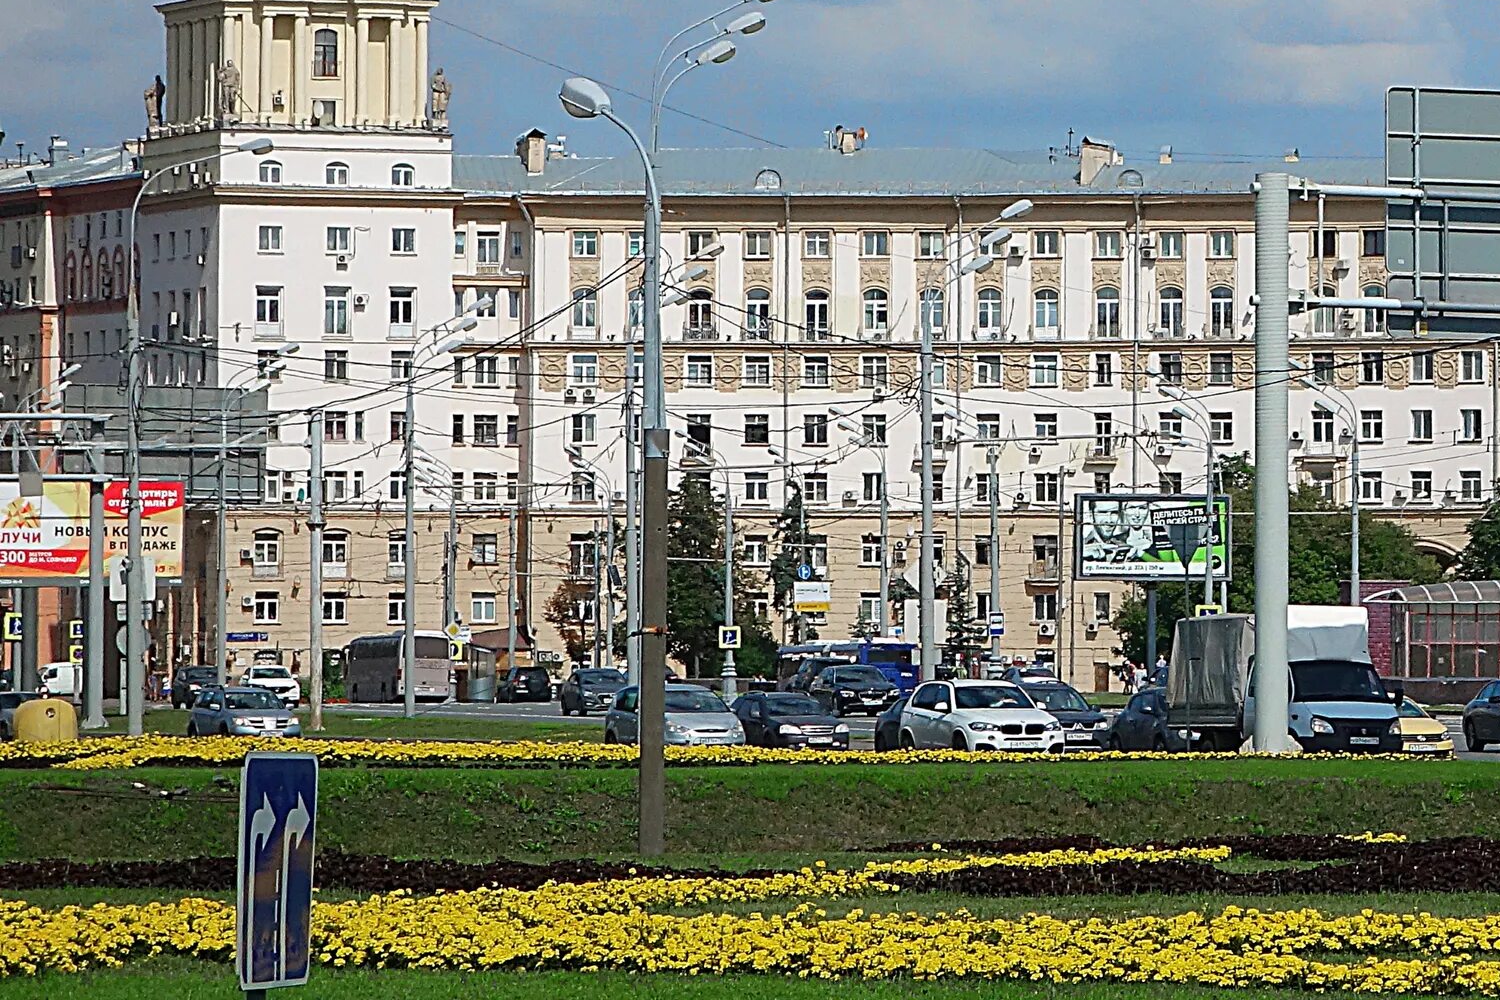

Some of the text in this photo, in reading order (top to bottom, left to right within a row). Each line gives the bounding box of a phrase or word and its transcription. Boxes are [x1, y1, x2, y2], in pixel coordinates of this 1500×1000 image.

[1188, 514, 1217, 524] СТРАЕ
[113, 526, 168, 537] КОПУС
[110, 541, 116, 550] В
